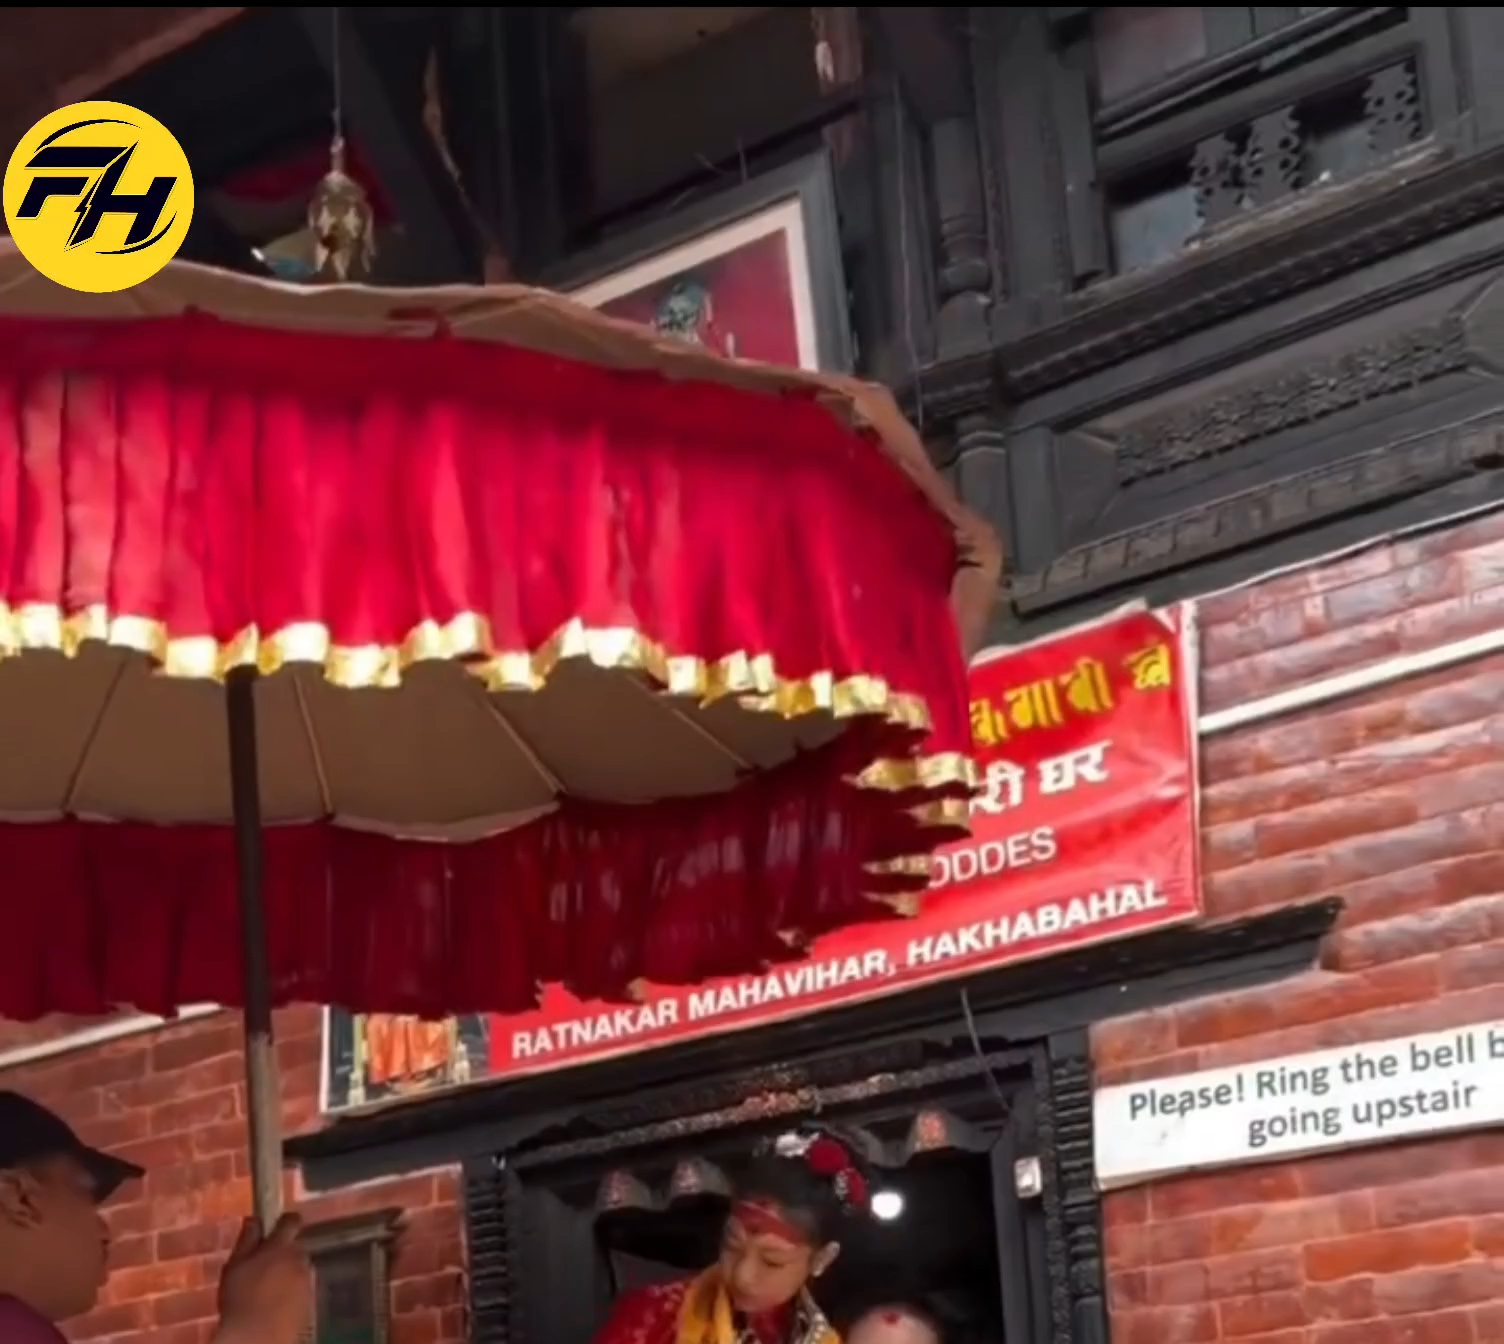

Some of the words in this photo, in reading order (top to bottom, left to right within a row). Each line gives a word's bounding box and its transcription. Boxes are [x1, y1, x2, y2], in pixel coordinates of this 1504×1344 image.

[1036, 738, 1114, 794] घर
[511, 998, 679, 1059] RATNAKAR
[688, 949, 897, 1021] MAHAVIHAR,
[906, 879, 1168, 967] HAKHABAHAL
[1128, 1074, 1245, 1121] Please!
[1256, 1064, 1330, 1100] Ring
[1339, 1053, 1399, 1084] the
[1409, 1032, 1475, 1073] bell
[1248, 1106, 1343, 1147] going
[1352, 1080, 1478, 1126] upstair
